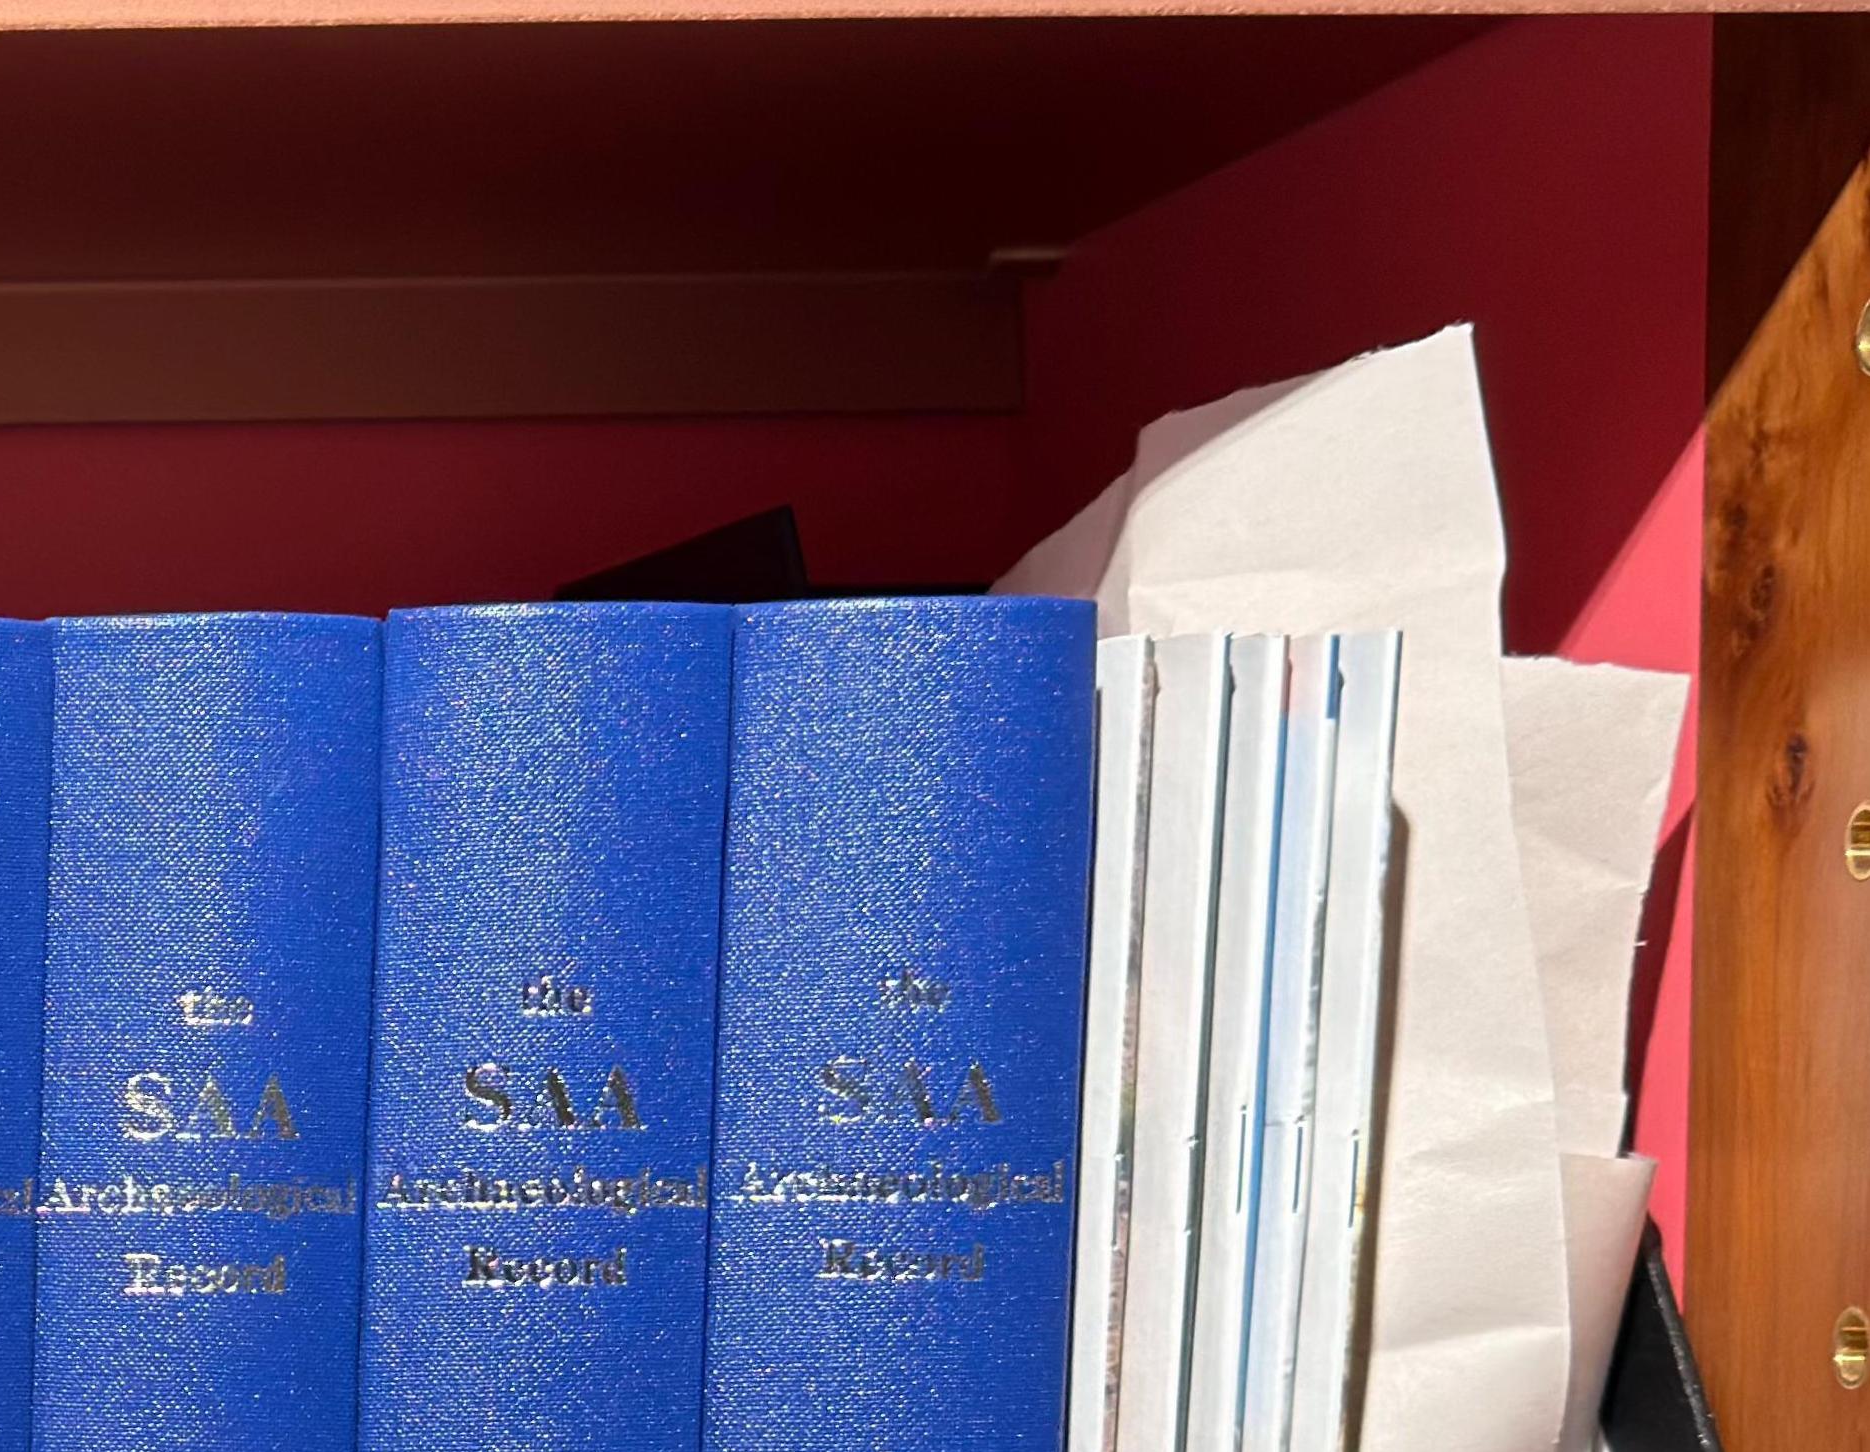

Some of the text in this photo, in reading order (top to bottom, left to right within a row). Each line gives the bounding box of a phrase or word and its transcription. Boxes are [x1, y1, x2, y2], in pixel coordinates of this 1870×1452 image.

[177, 985, 253, 1026] the
[123, 1071, 300, 1142] SAA
[464, 1063, 646, 1131] SAA
[817, 1055, 1002, 1127] SAA
[37, 1175, 357, 1219] Archaeological
[377, 1163, 707, 1214] Archaeological
[124, 1252, 286, 1294] Record
[463, 1245, 627, 1287] Record
